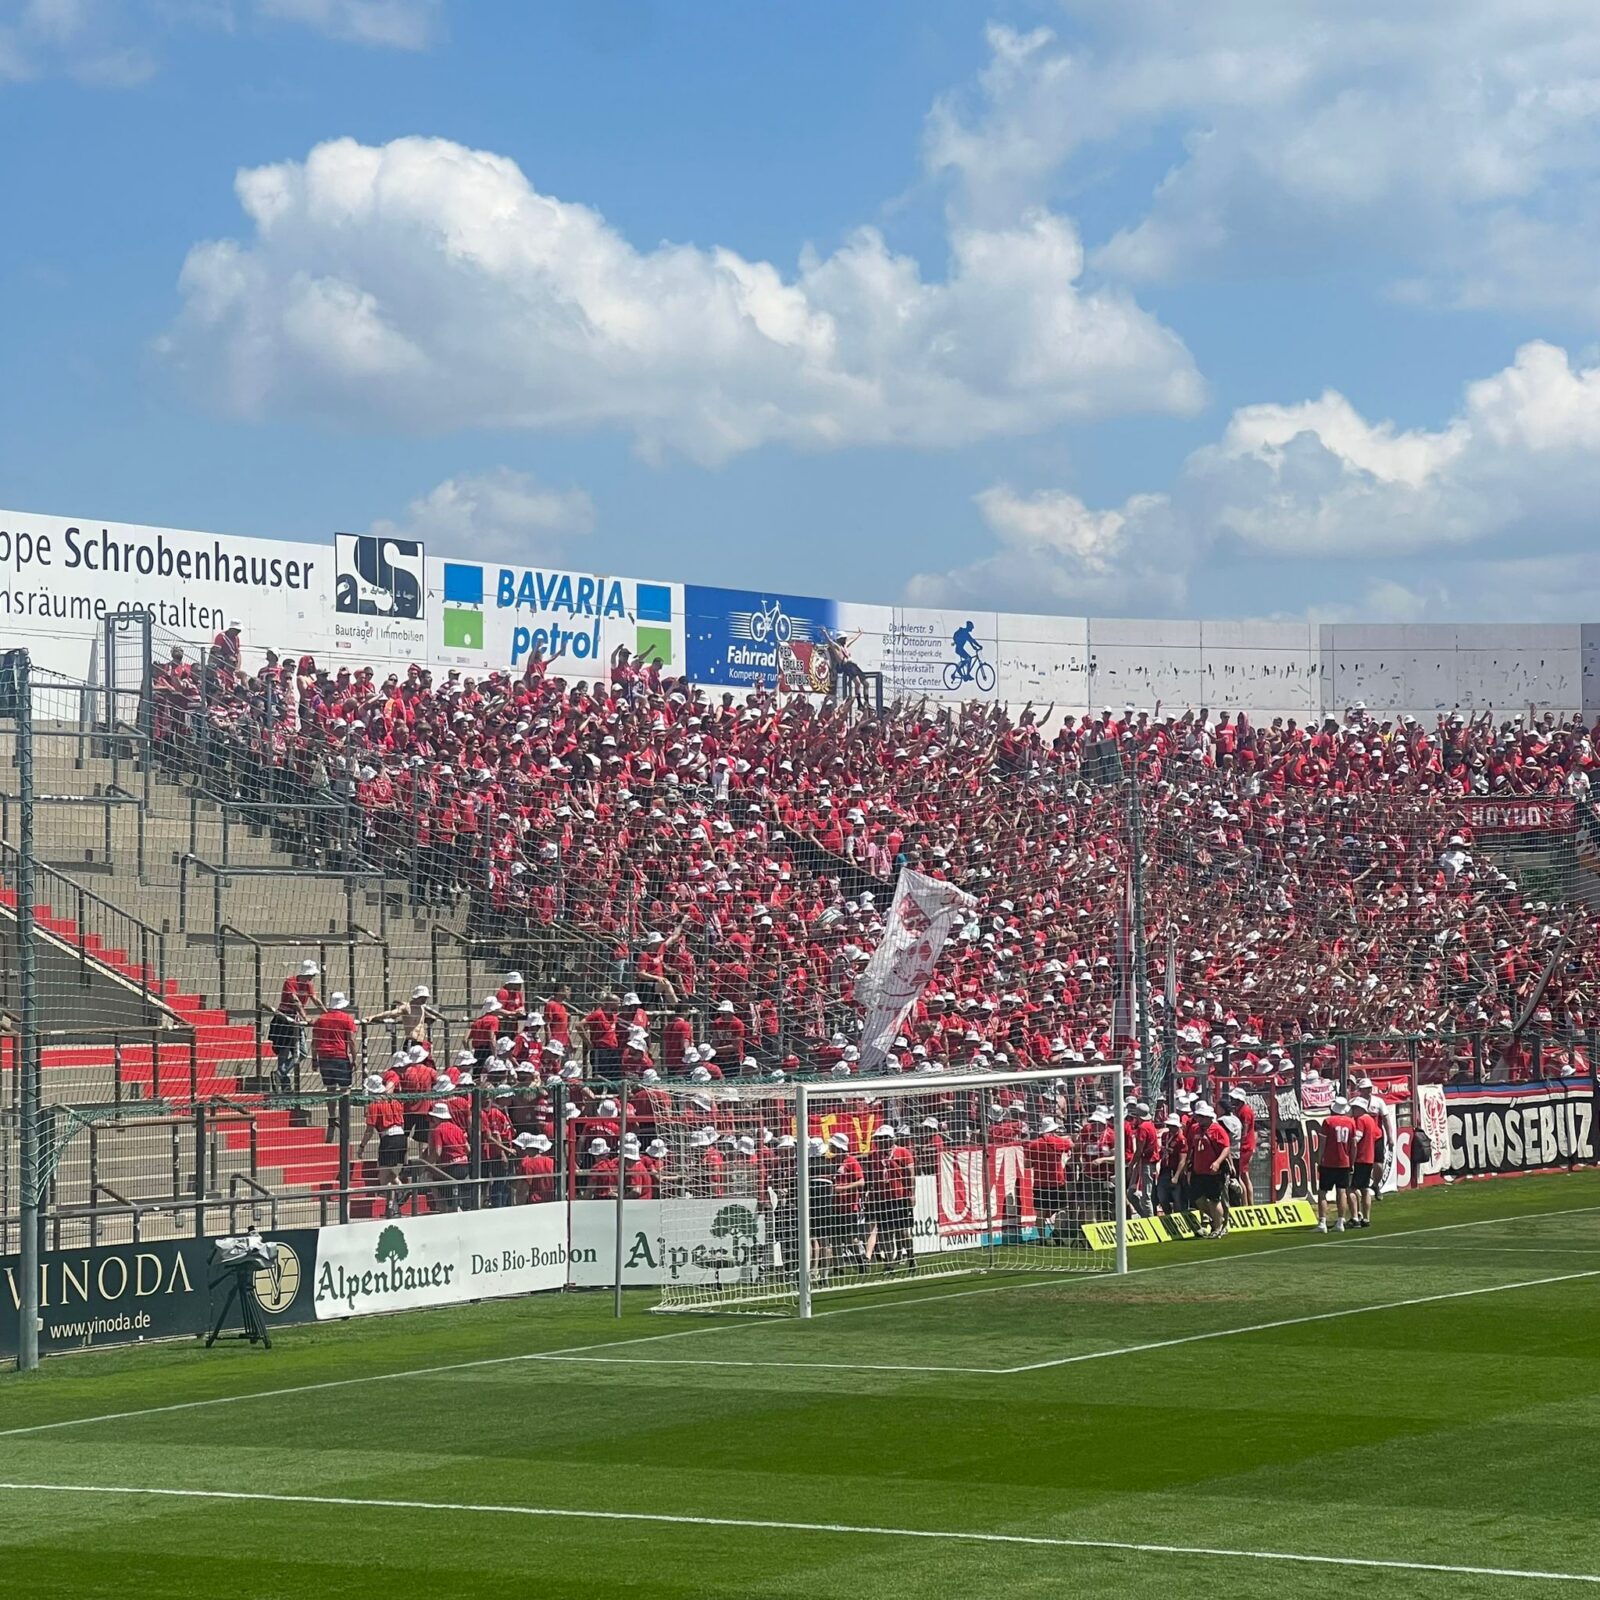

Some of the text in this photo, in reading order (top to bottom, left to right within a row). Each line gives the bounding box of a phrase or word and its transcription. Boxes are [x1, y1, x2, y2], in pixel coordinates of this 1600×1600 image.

[64, 527, 314, 590] Schrobenhauser
[497, 568, 625, 618] BAVARIA
[117, 597, 225, 631] gestalten
[335, 624, 425, 642] Bauträger Immobilien
[888, 622, 934, 634] Daimlerstr. 9
[510, 618, 601, 666] petrol
[882, 648, 942, 659] w.fahrrad-sperk.de
[902, 636, 942, 648] Ottobrunn
[727, 645, 777, 668] Fahrrad
[880, 662, 935, 674] Meisterwerkstatt
[918, 677, 942, 687] Center
[1334, 1125, 1350, 1143] 10
[1446, 1097, 1594, 1171] CHOŚEBUZ
[911, 1216, 938, 1237] uer
[1095, 1222, 1148, 1246] AUFLASI
[946, 1232, 978, 1246] AVANTI
[471, 1243, 597, 1275] Das Bio-Bonbon
[315, 1260, 454, 1310] Alpenbauer
[50, 1311, 151, 1340] www.vinoda.de
